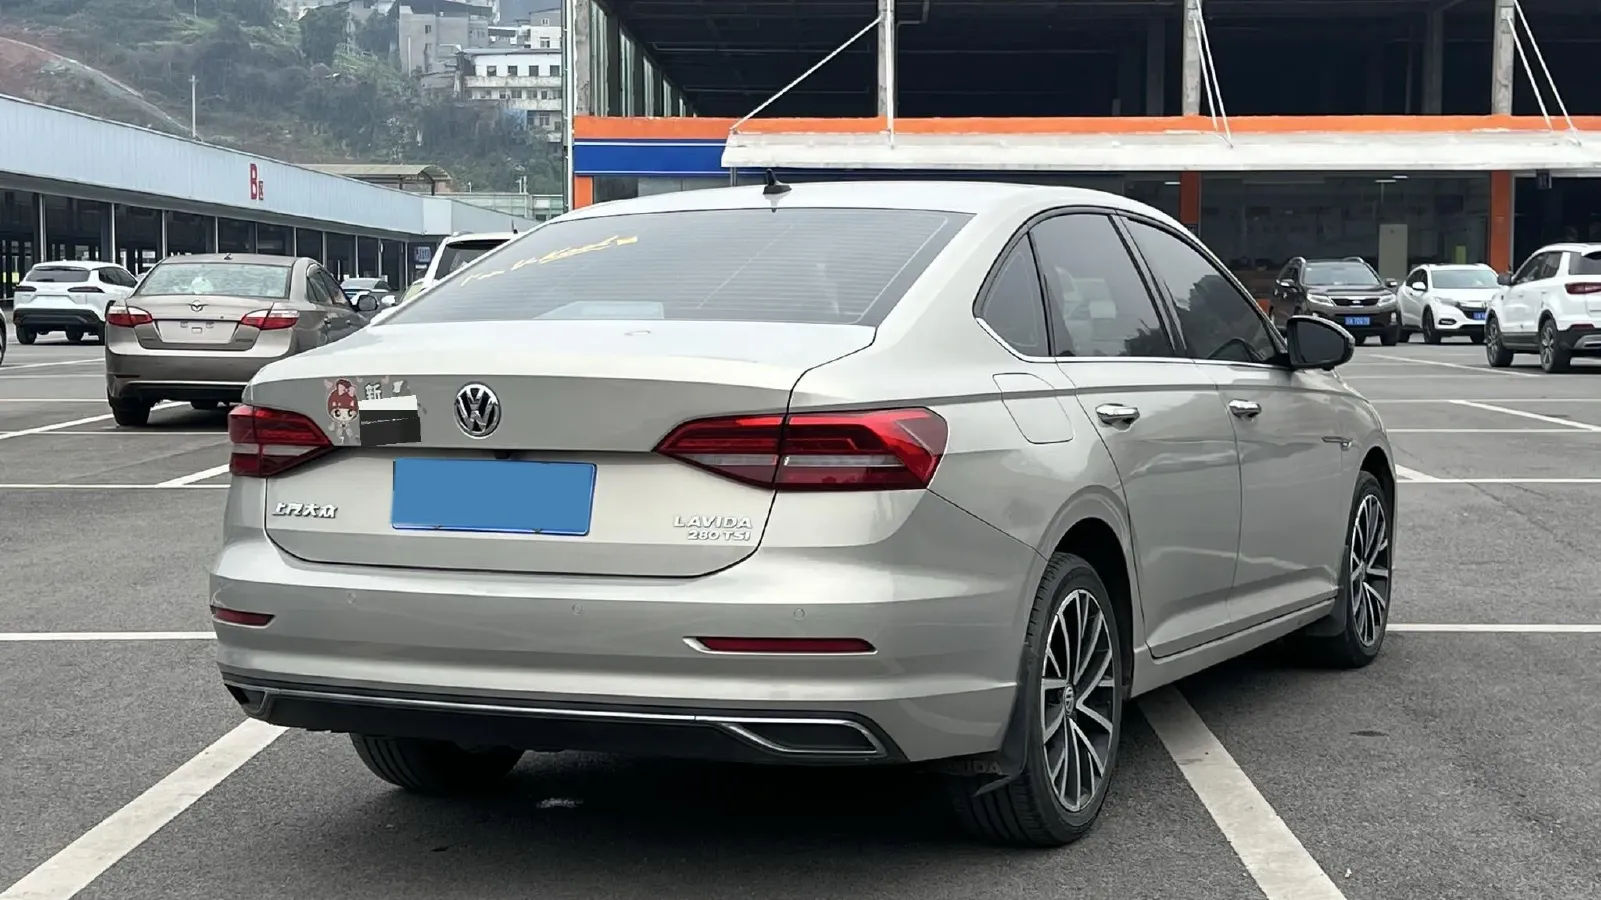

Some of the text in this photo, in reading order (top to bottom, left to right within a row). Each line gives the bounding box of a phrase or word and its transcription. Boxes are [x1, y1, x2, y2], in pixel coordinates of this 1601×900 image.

[673, 515, 753, 529] LAVIDA
[687, 529, 752, 541] 280 TSI
